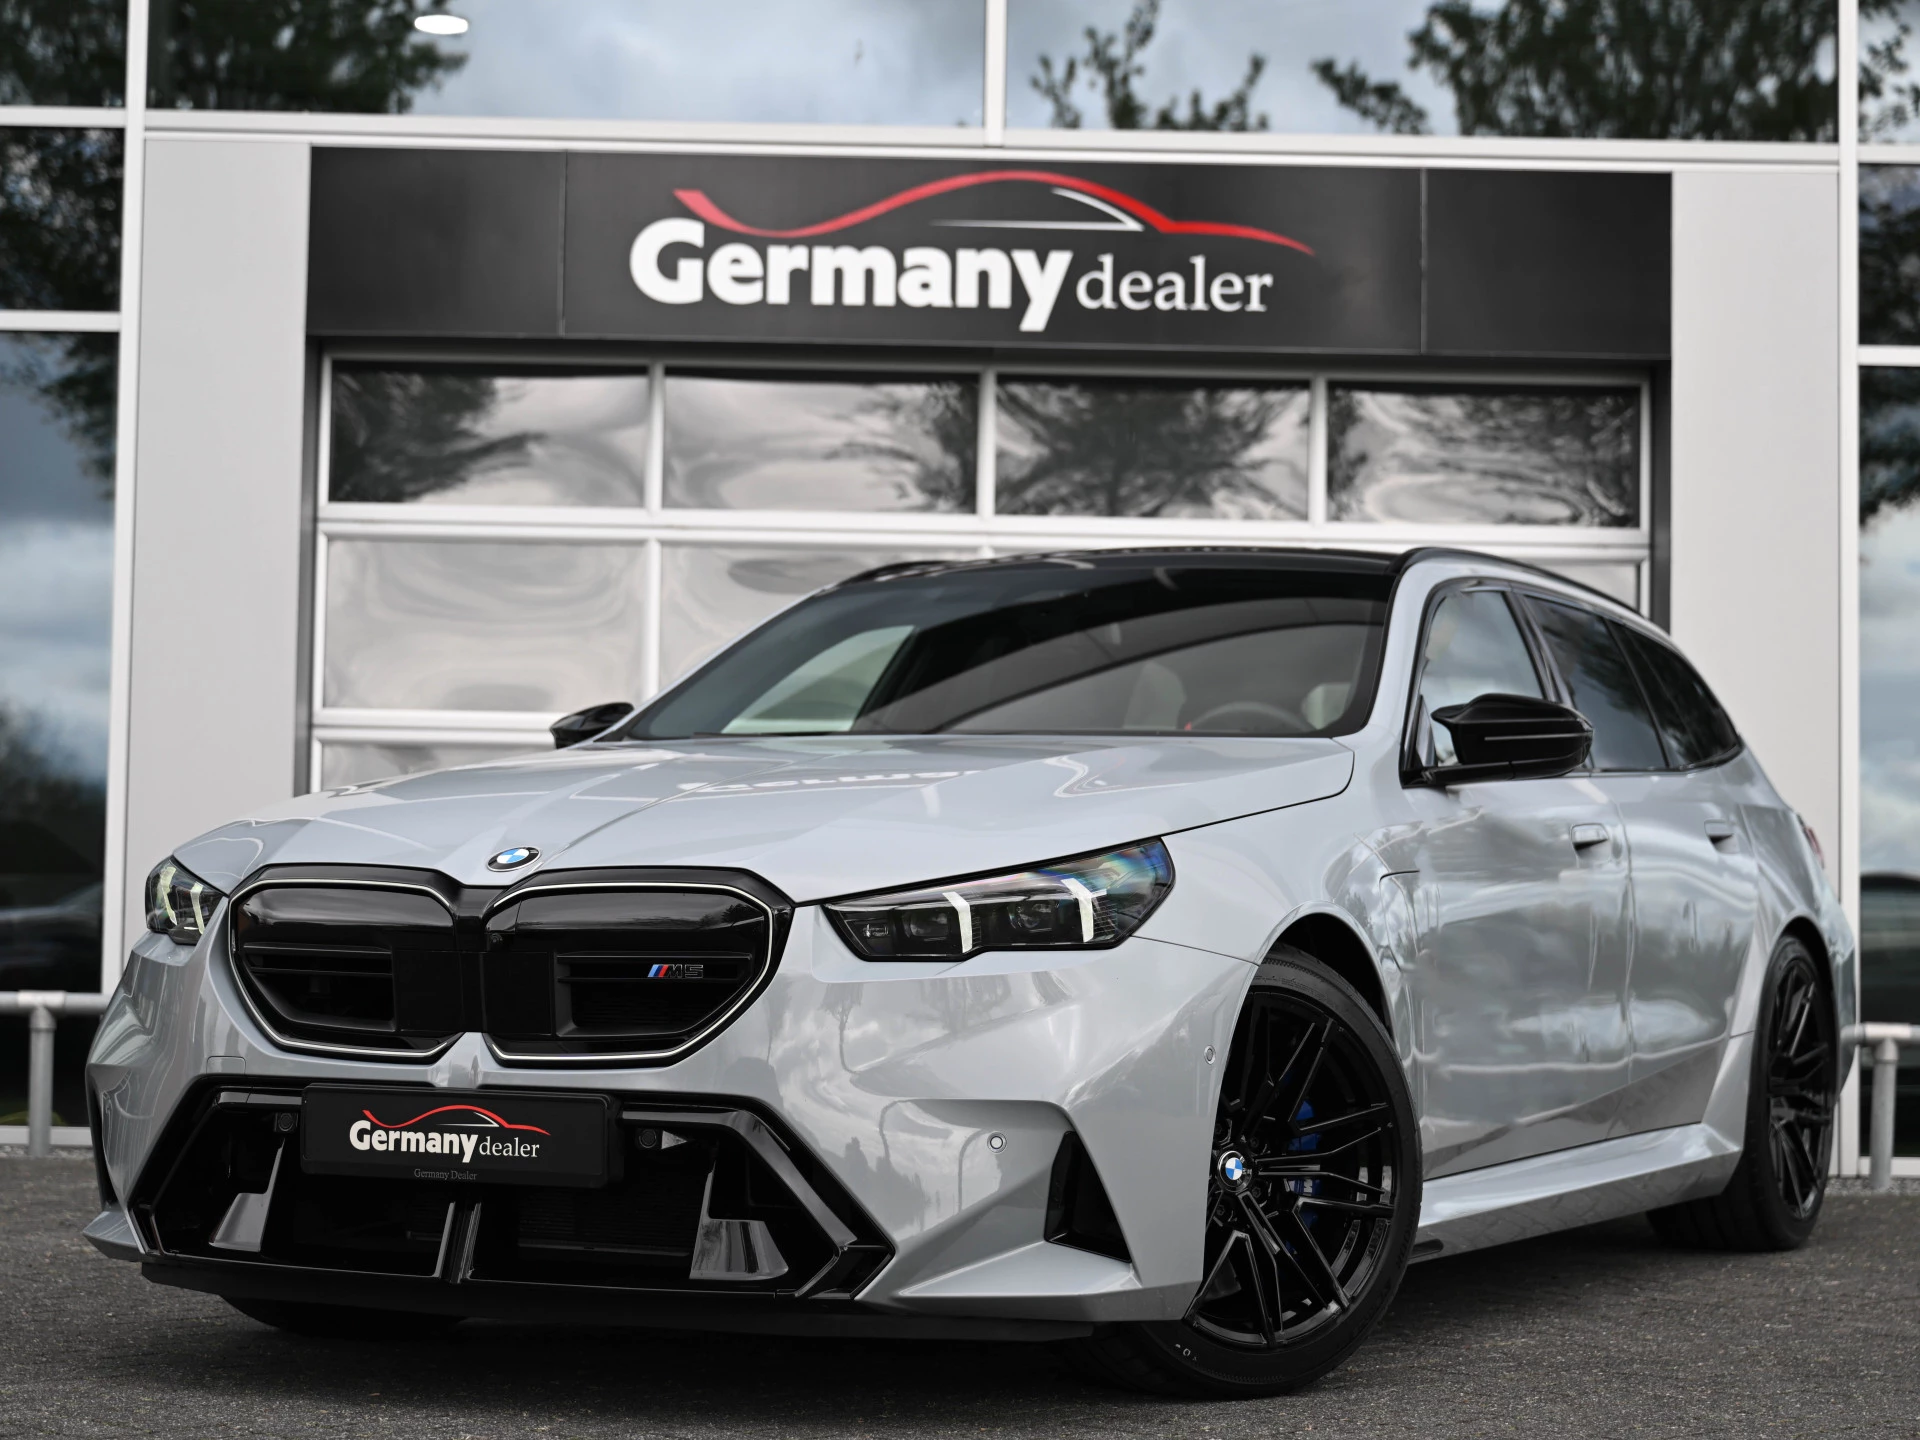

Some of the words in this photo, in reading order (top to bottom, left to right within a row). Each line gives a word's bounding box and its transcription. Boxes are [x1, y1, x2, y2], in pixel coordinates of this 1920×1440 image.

[629, 217, 1073, 332] Germany
[1076, 253, 1273, 312] dealer
[663, 963, 704, 979] M5
[349, 1119, 478, 1163] Germany
[478, 1136, 540, 1158] dealer
[413, 1168, 450, 1181] Germany
[450, 1169, 478, 1181] Dealer
